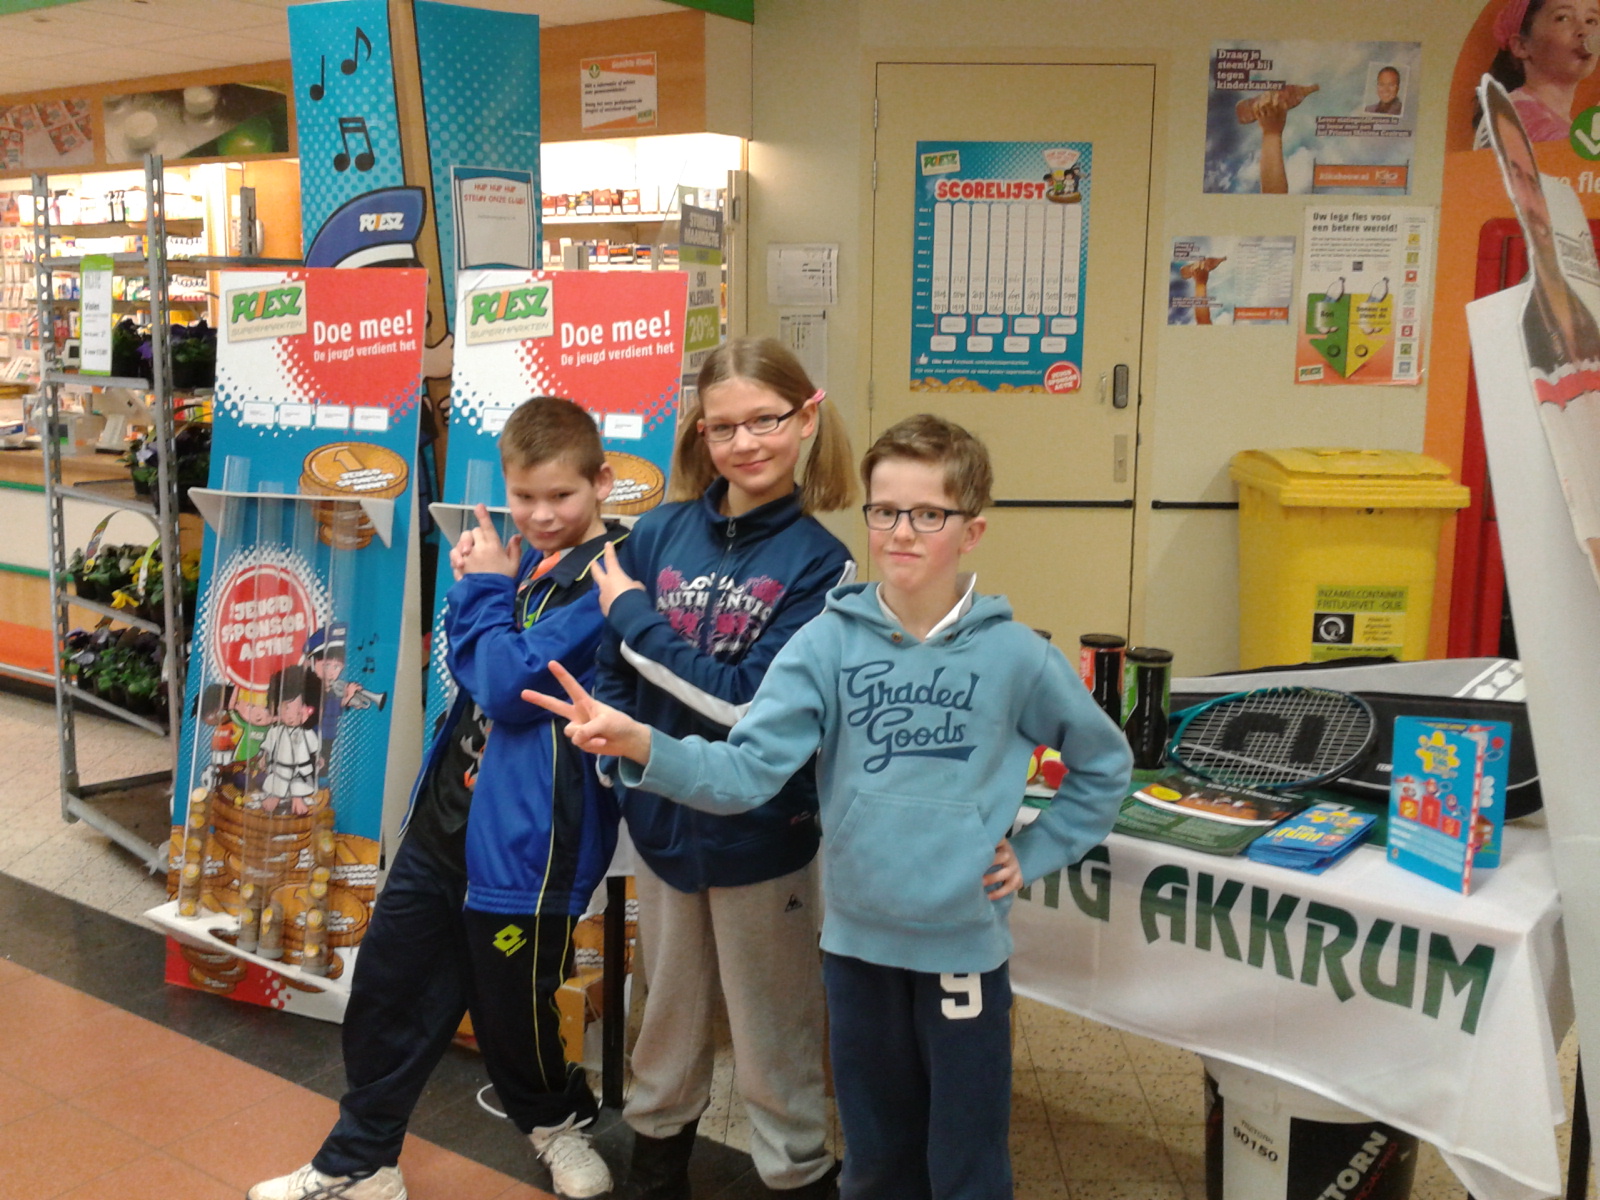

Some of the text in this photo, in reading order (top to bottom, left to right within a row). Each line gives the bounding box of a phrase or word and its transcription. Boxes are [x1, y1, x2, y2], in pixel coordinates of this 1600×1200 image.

[1217, 61, 1271, 70] steentje bij
[1218, 51, 1260, 61] Draag je
[1217, 72, 1244, 80] tegen
[1217, 81, 1283, 90] kinderkanker
[936, 180, 1046, 200] SCORELIJST
[359, 212, 404, 232] POIESZ
[1313, 212, 1391, 223] Uw lege fles voor
[1332, 224, 1360, 232] betere
[1363, 224, 1398, 233] wereld!
[231, 287, 302, 324] POIESZ
[470, 286, 549, 326] POIESZ
[232, 321, 302, 337] SUPERMARKTEN
[313, 309, 413, 345] Doe mee!
[470, 322, 549, 339] SUPERMARKTEN
[561, 310, 671, 349] Doe mee!
[689, 314, 715, 344] 20%
[314, 340, 416, 363] De jeugd verdient het
[561, 342, 675, 367] De jeugd verdient het
[233, 595, 293, 621] JEUGD
[222, 612, 305, 643] SPONSOR
[239, 636, 294, 661] ACTIE
[841, 660, 981, 727] Graded
[863, 706, 974, 774] Goods
[1140, 864, 1496, 1036] AKKRUM
[1233, 1126, 1278, 1162] 90150
